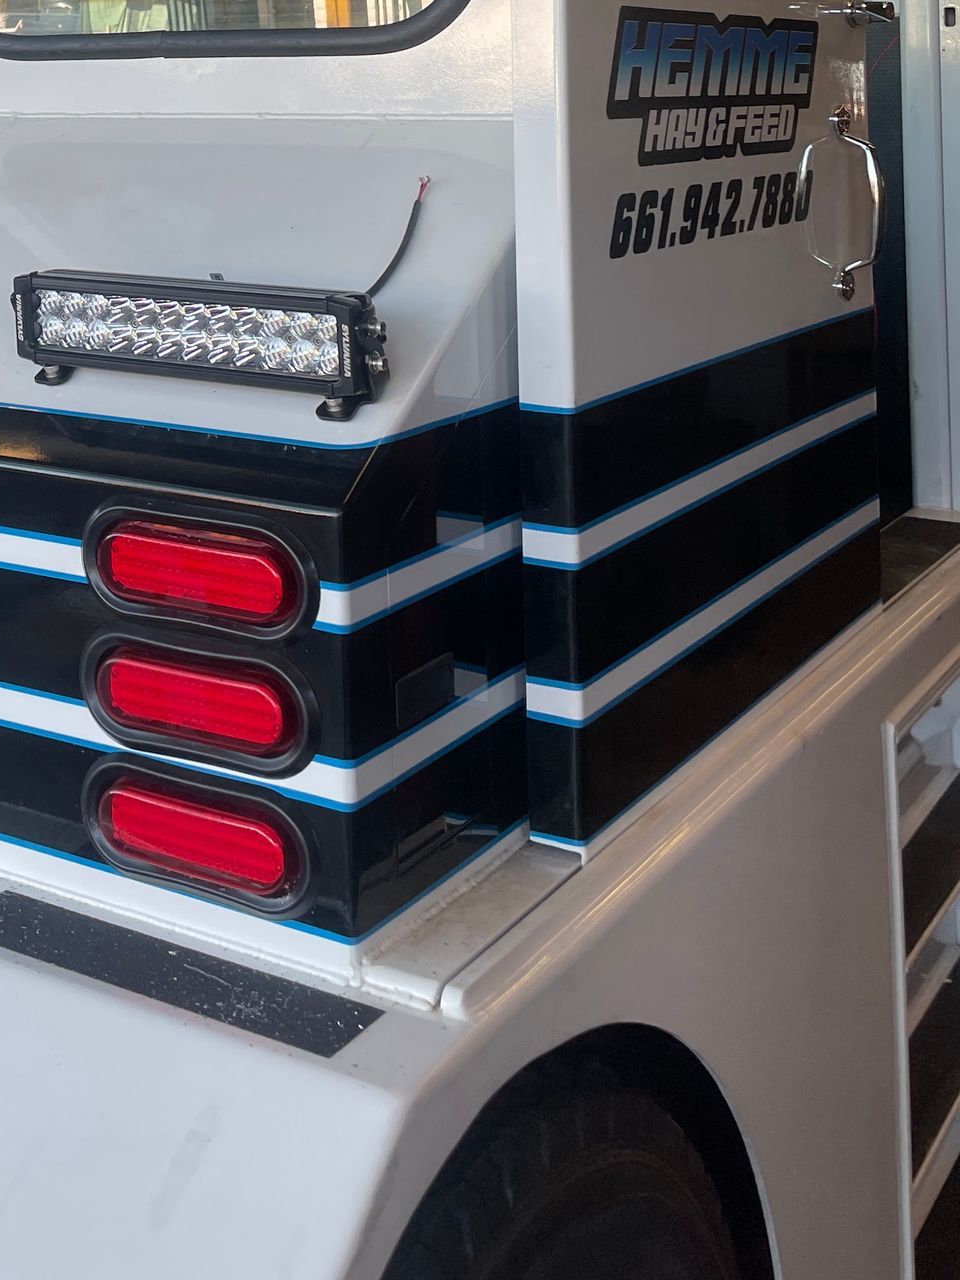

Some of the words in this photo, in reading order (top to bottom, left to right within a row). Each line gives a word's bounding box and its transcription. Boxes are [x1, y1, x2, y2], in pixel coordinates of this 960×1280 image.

[612, 19, 816, 102] HEMME
[15, 293, 24, 342] SYLVANIA
[341, 323, 352, 378] SYLVANIA
